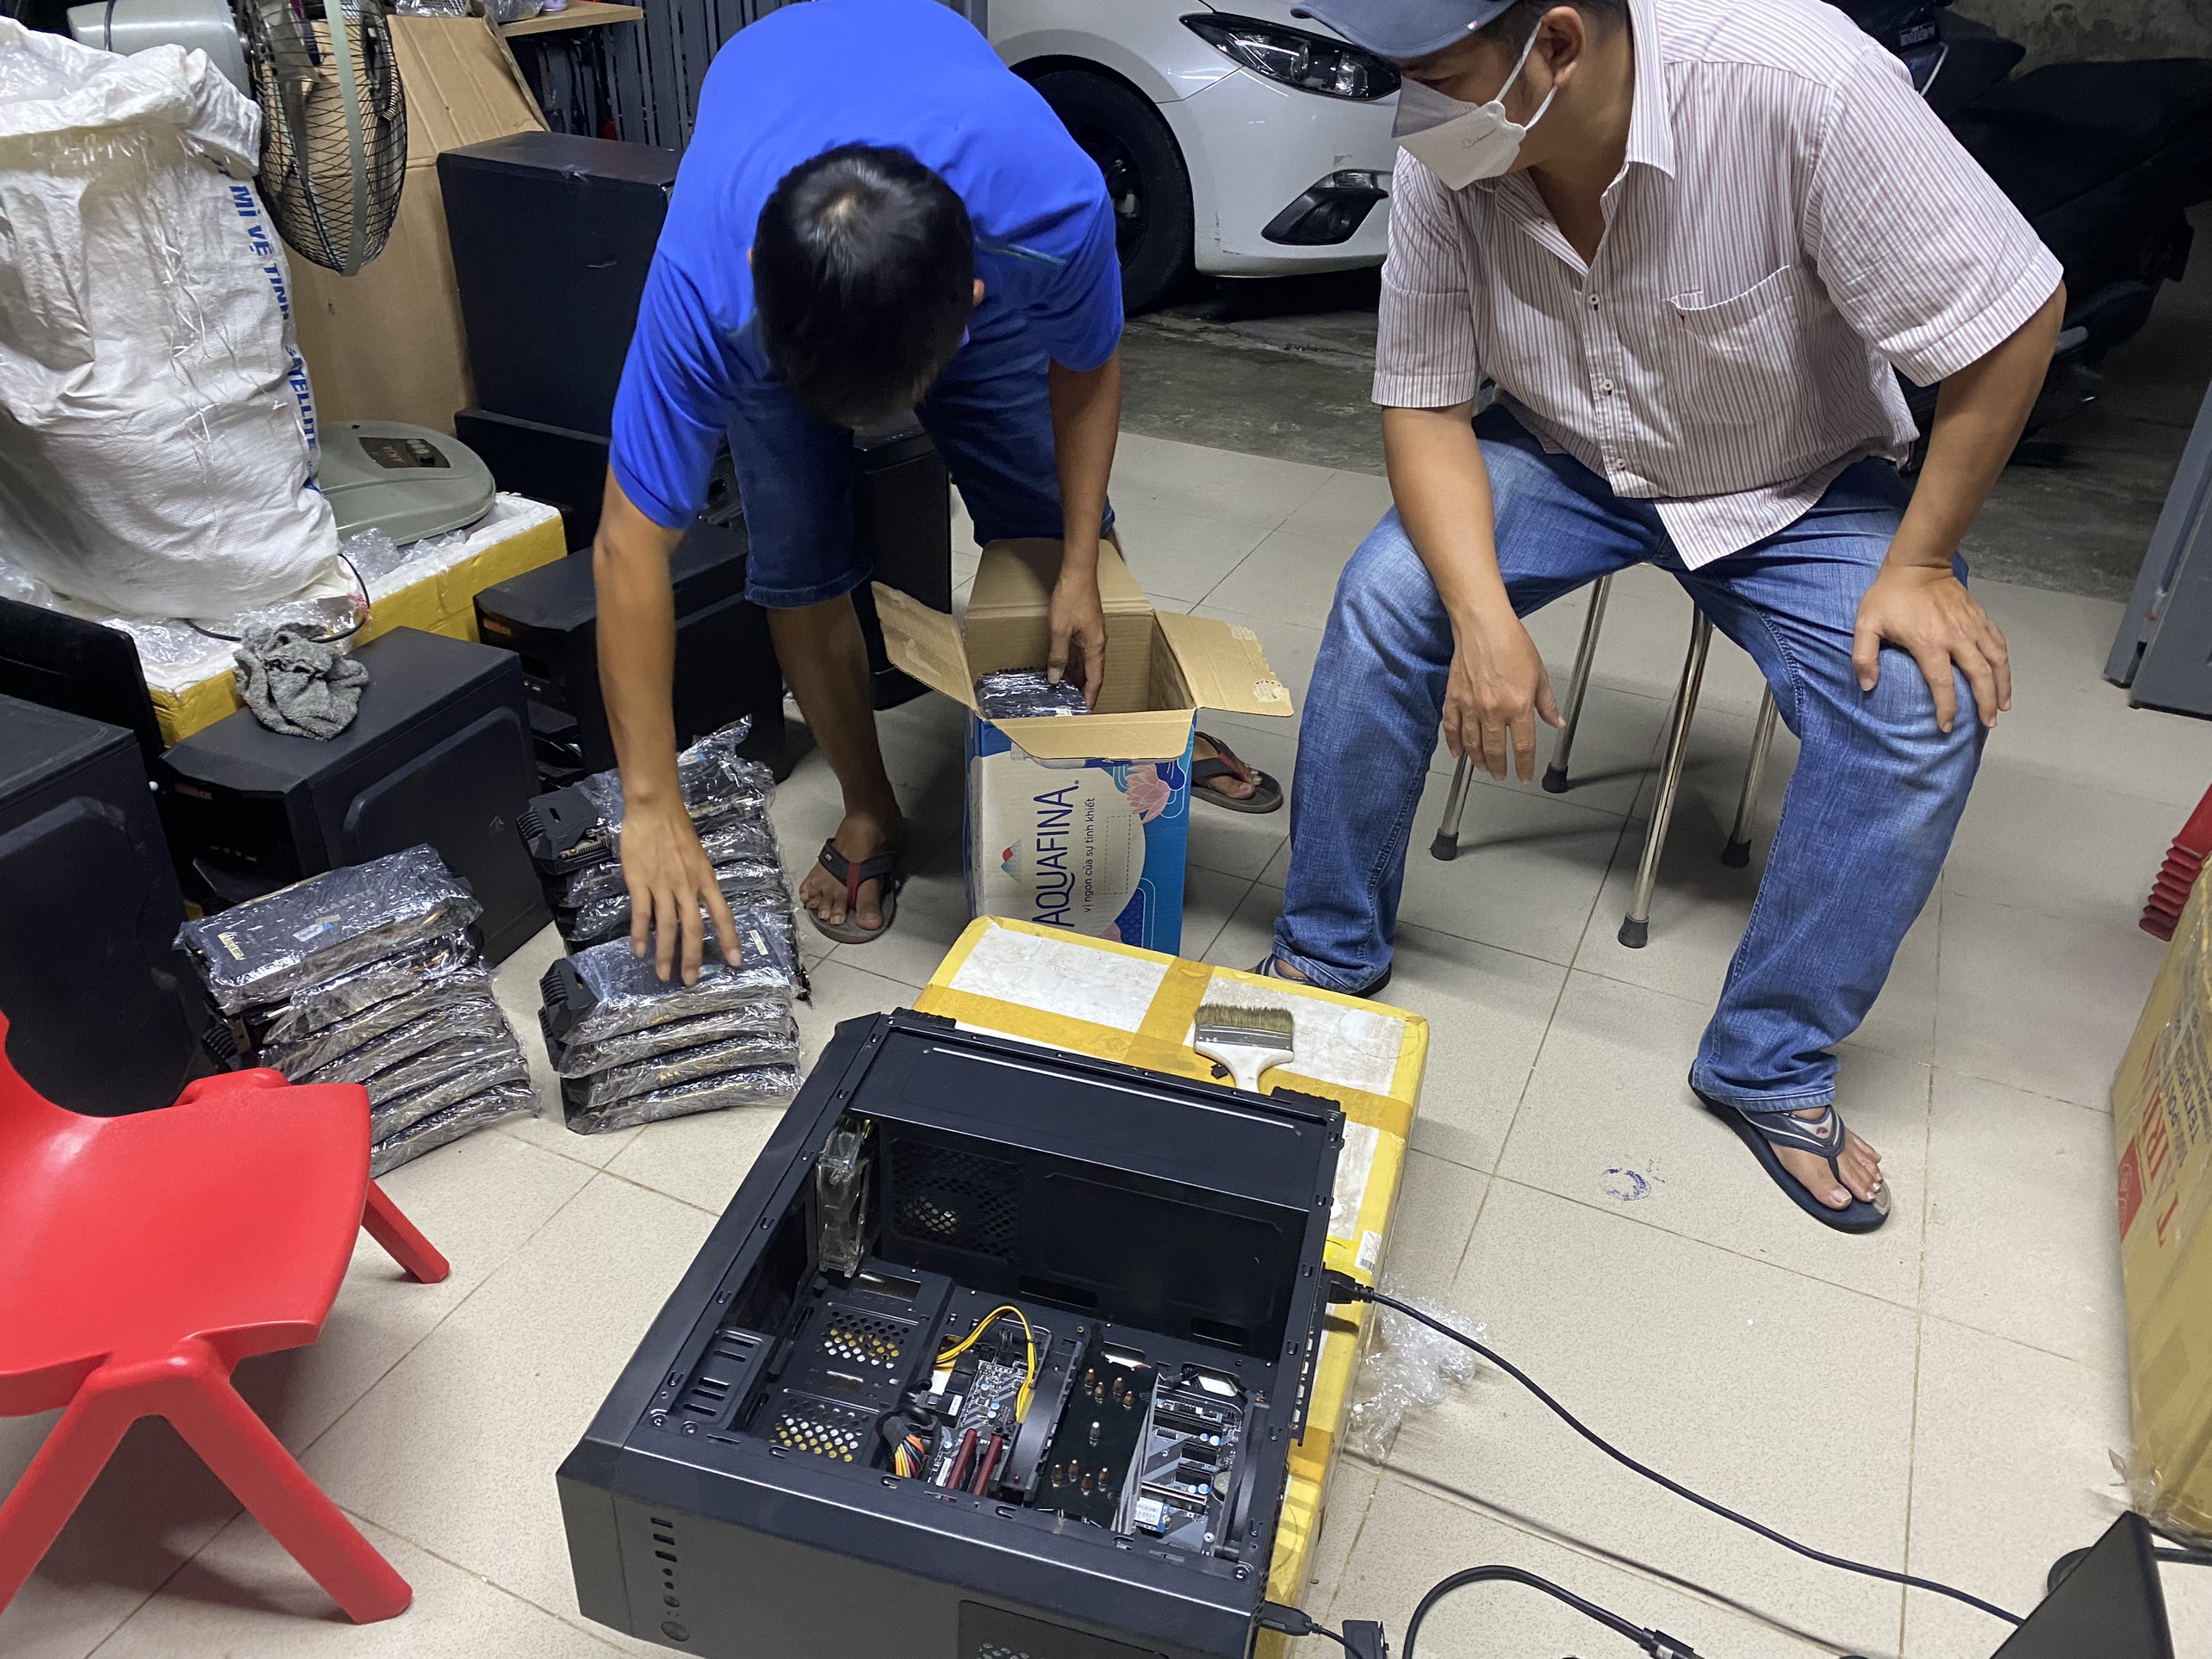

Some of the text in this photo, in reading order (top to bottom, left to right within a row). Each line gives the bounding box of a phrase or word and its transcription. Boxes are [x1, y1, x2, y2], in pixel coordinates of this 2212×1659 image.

[247, 225, 274, 256] VỆ
[284, 345, 317, 451] SATELLITE
[1084, 797, 1096, 822] khiết
[1084, 824, 1094, 843] tinh
[1032, 785, 1079, 928] AQUAFINA
[1085, 845, 1096, 856] sự
[1083, 859, 1093, 876] của
[1084, 879, 1094, 902] ngon
